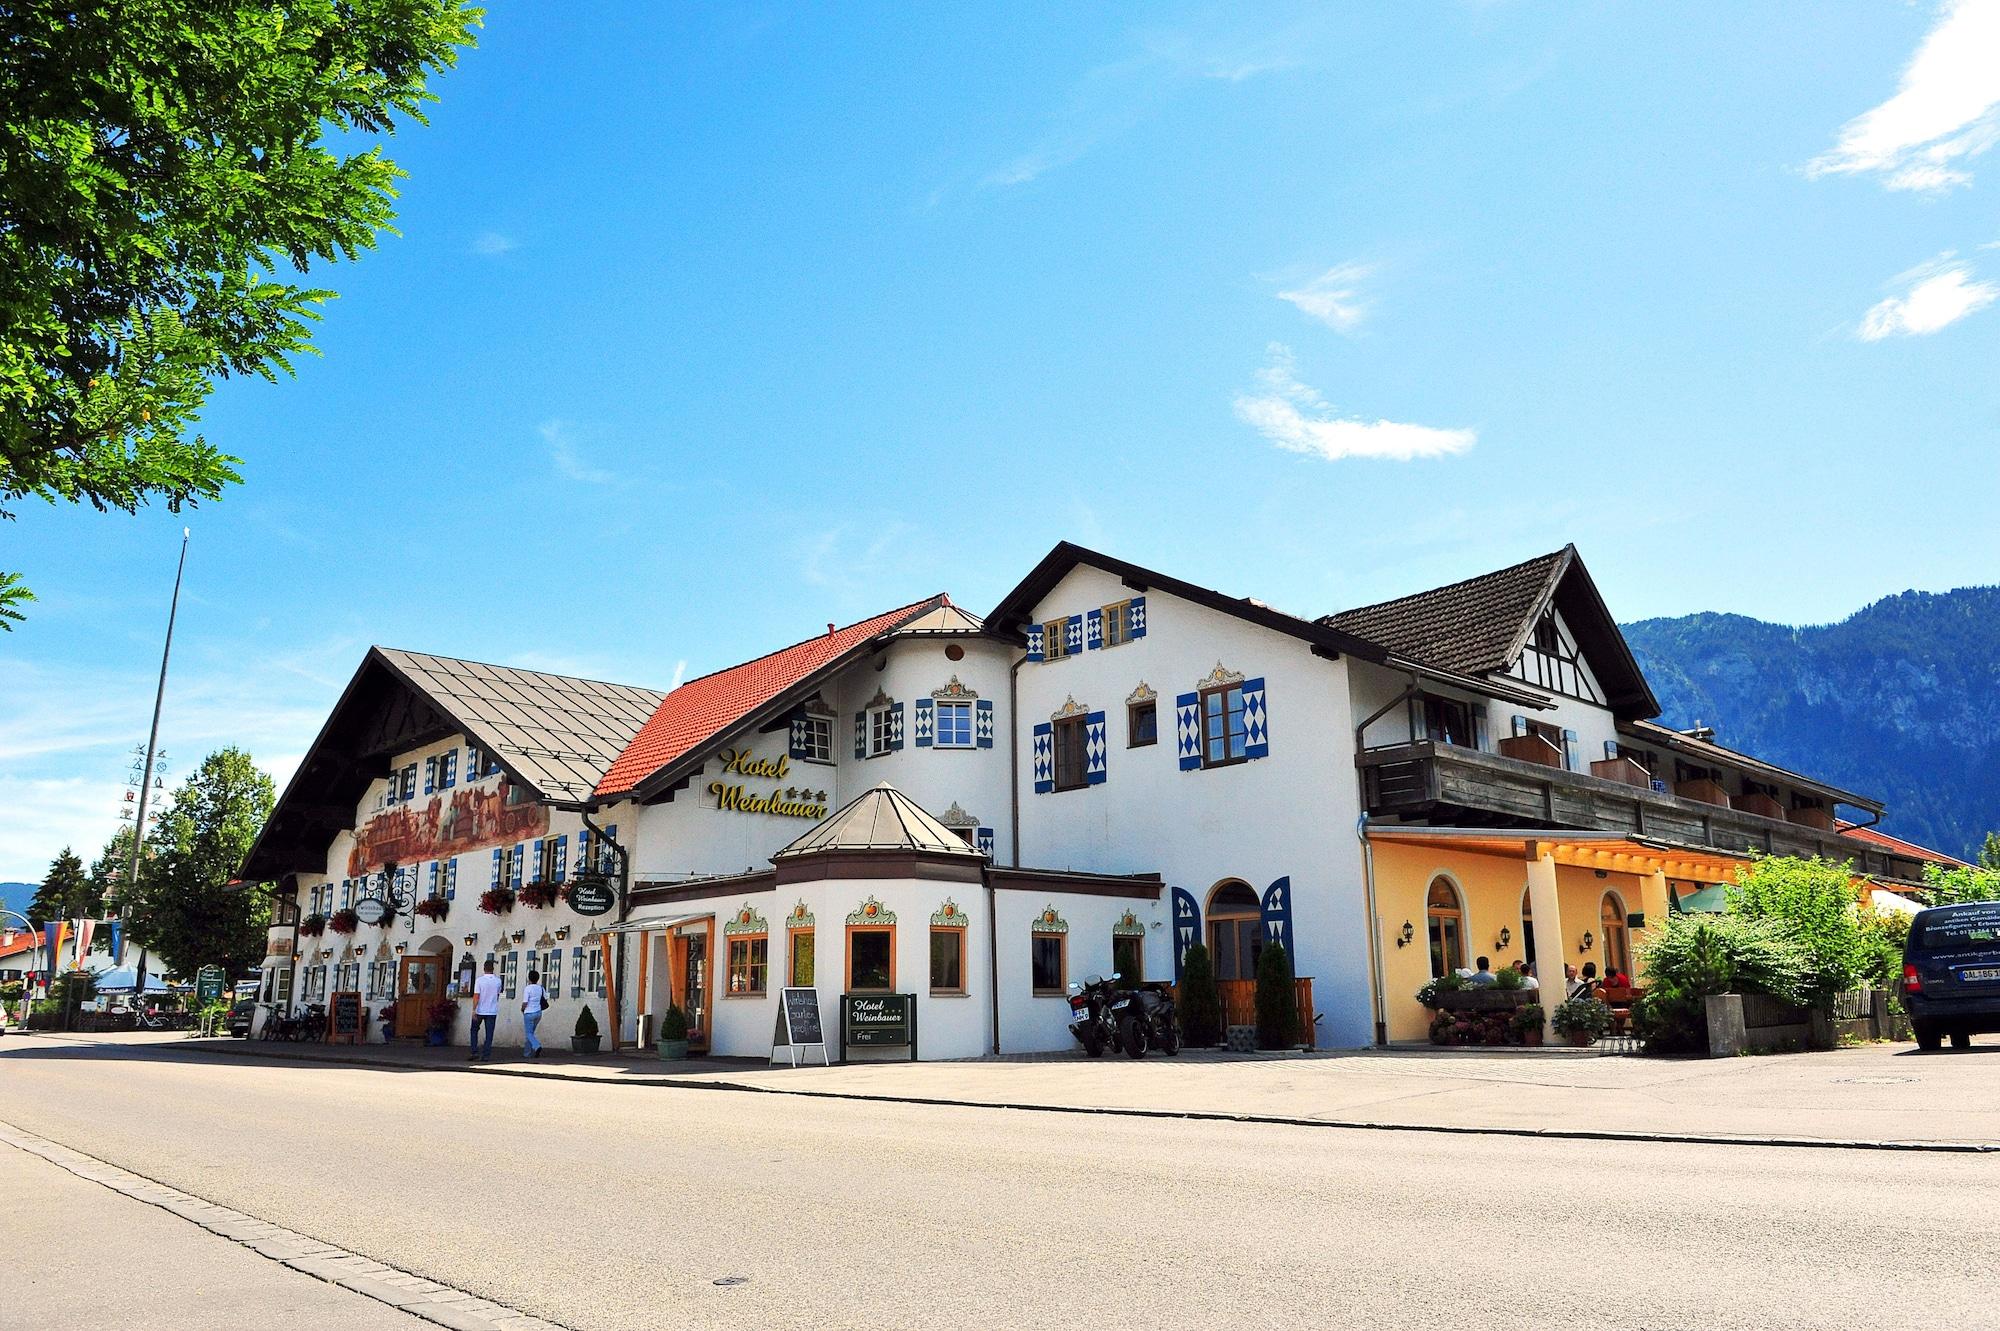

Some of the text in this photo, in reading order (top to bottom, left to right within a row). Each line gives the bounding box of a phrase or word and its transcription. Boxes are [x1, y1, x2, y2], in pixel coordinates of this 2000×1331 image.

[718, 748, 790, 779] Hotel
[708, 781, 828, 819] Weinbauer
[577, 886, 597, 895] Hotel
[575, 894, 607, 903] Weinbauer
[577, 903, 605, 911] Rezeption
[1926, 923, 1972, 931] Bronzefiguren
[1932, 950, 2000, 959] www.antikgerb
[854, 1000, 885, 1011] Hotel
[852, 1011, 902, 1022] Weinbauer
[857, 1032, 872, 1040] Frei
